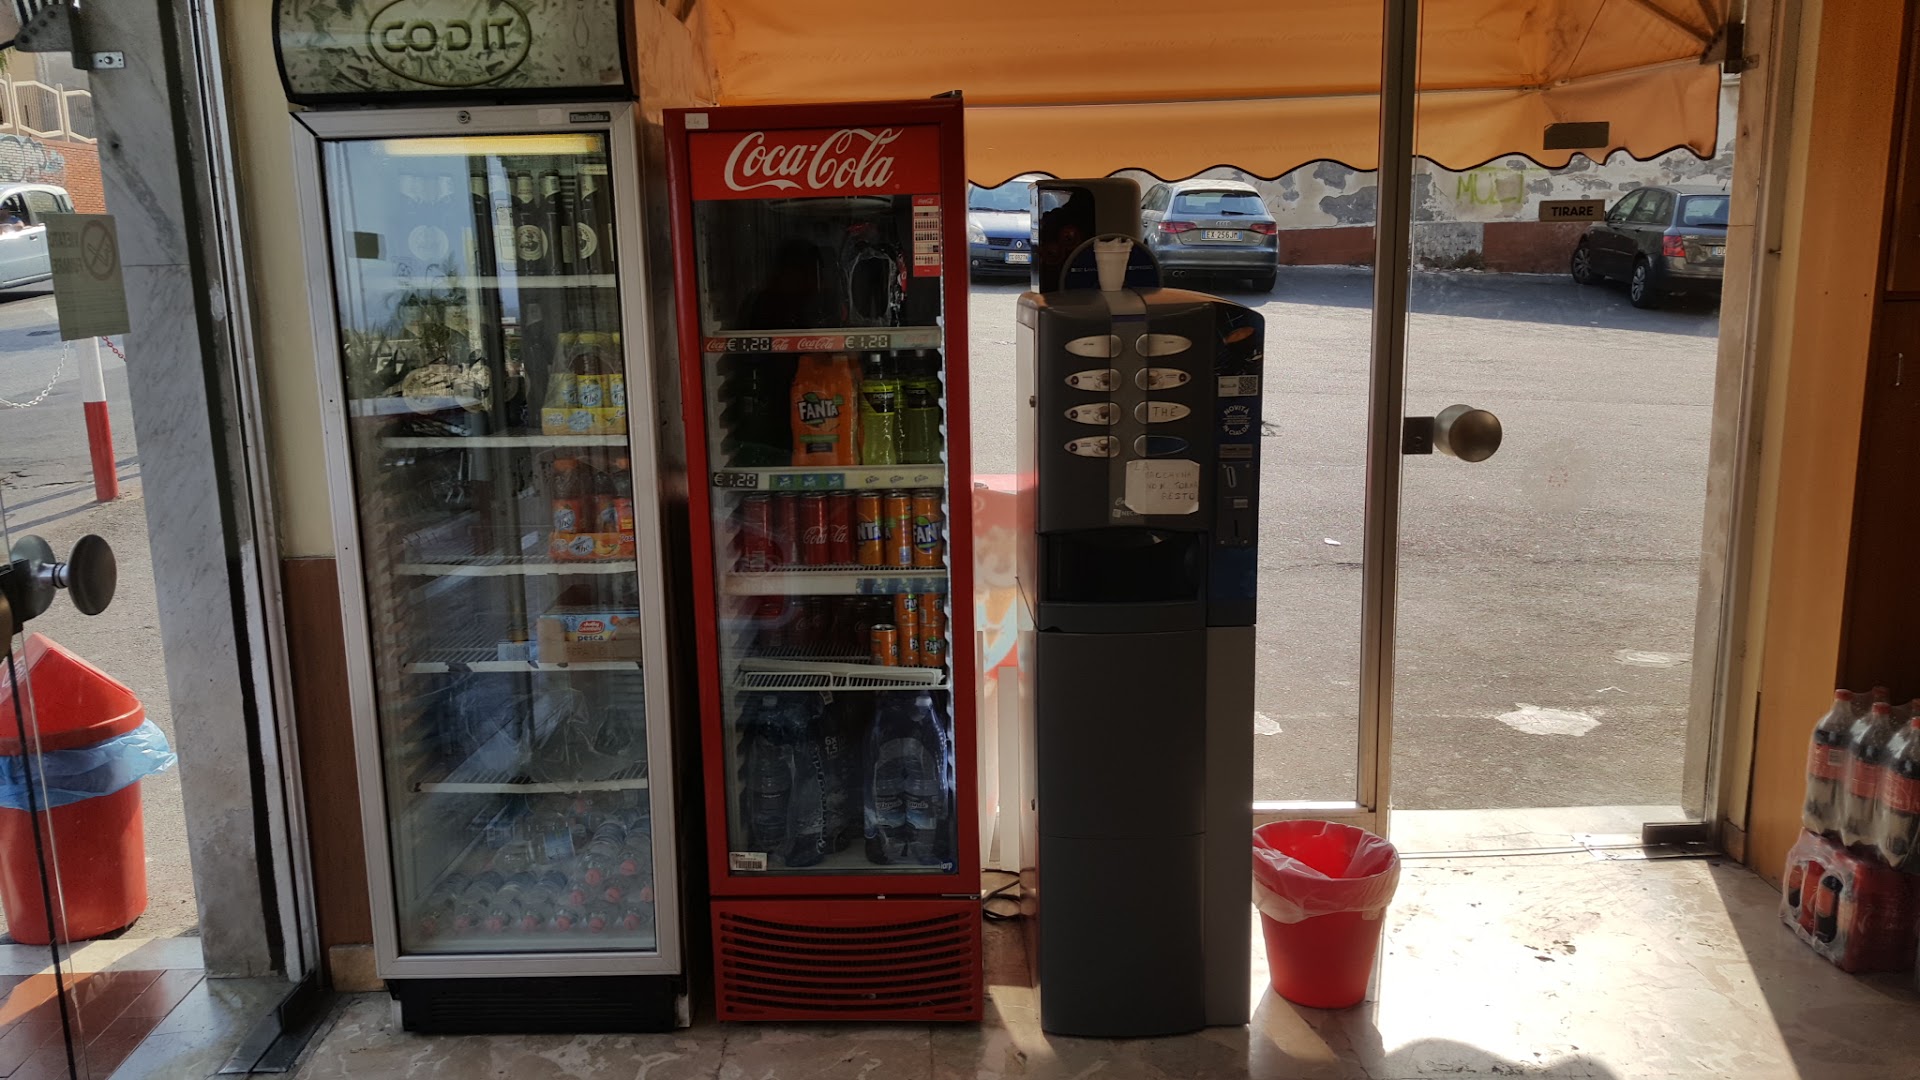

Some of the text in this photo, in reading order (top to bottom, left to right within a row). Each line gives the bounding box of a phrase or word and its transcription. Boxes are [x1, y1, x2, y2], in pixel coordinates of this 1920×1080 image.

[724, 128, 905, 192] Coca-Cola
[1550, 206, 1594, 217] TIRARE
[798, 400, 839, 421] FANTA
[1161, 492, 1196, 501] RESTO
[577, 635, 605, 643] pesca
